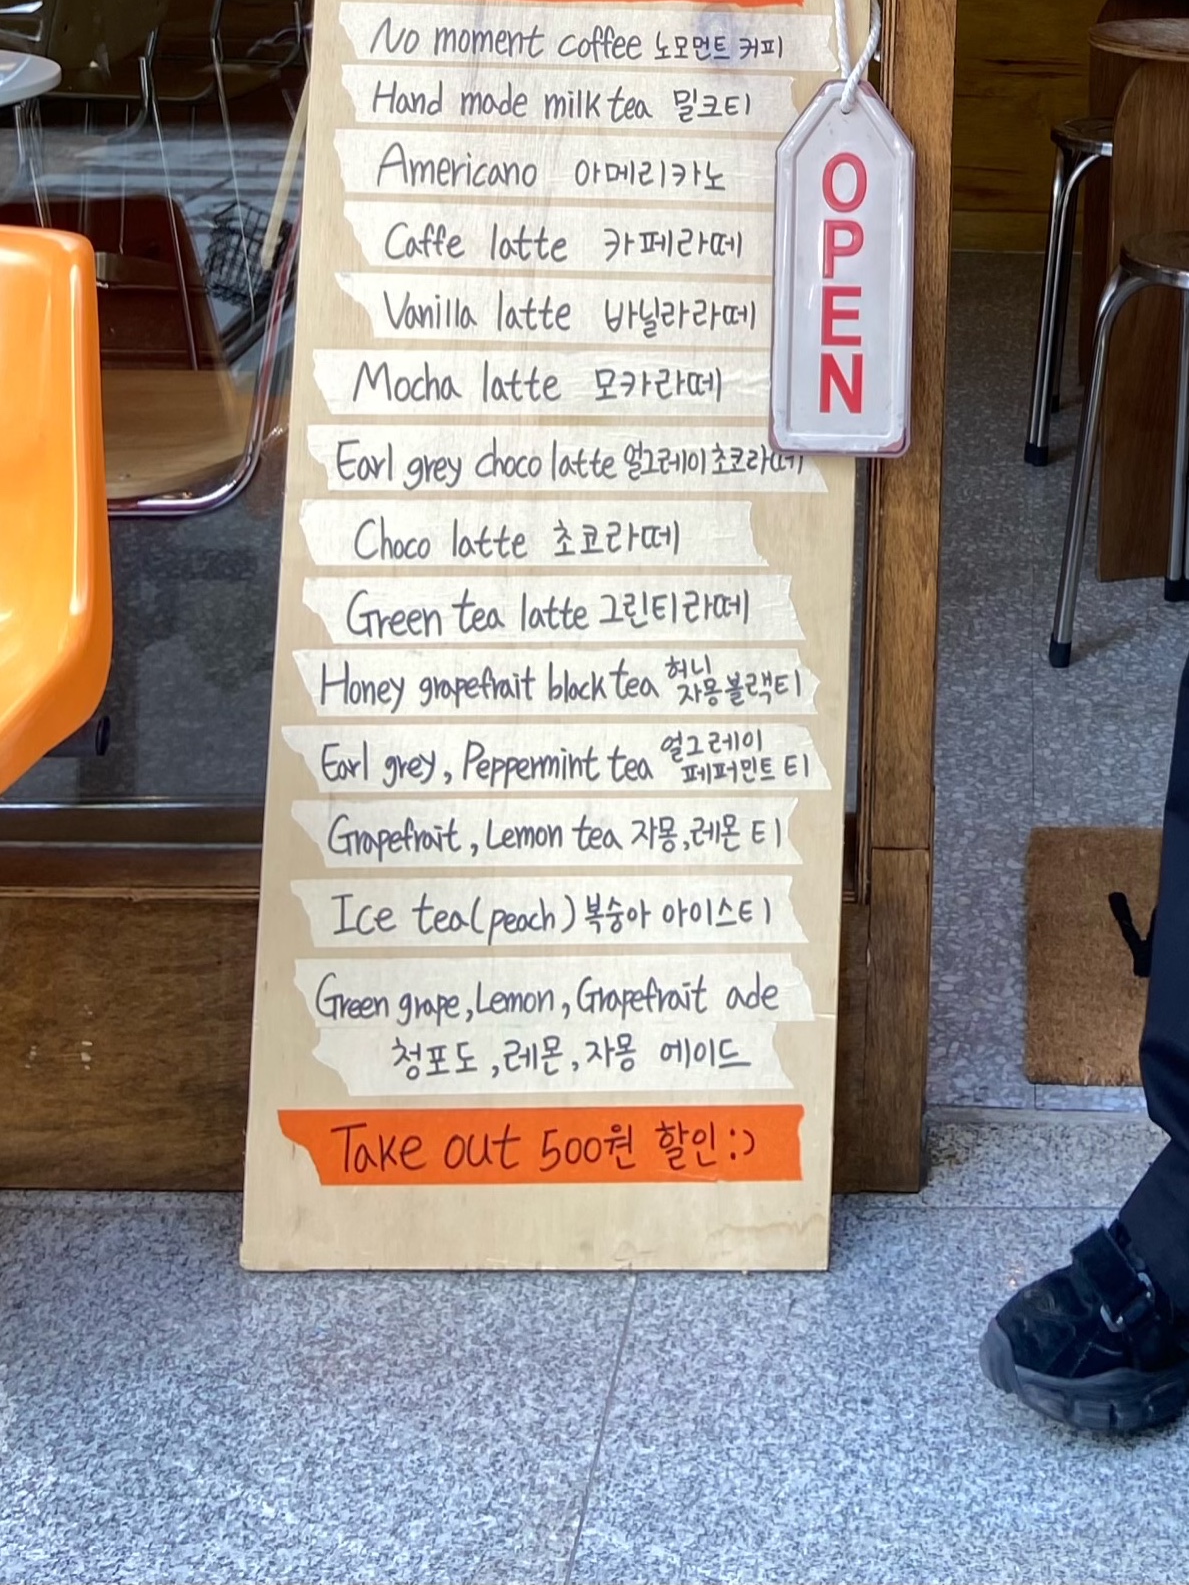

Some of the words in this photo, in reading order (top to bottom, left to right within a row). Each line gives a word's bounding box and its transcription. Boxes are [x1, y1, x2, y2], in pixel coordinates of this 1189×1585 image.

[369, 17, 420, 57] No
[434, 19, 545, 60] moment
[558, 31, 643, 61] coffee
[654, 32, 731, 61] 노모먼트
[739, 35, 784, 60] 커피
[372, 79, 443, 117] Hand
[460, 79, 528, 117] made
[545, 81, 601, 120] milk
[607, 84, 653, 120] tea
[673, 88, 752, 119] 밀크티
[377, 142, 538, 190] Americano
[575, 159, 727, 193] 아메리카노
[384, 221, 466, 261] Caffe
[491, 223, 569, 264] latte
[604, 227, 743, 260] 카페라떼
[818, 151, 868, 415] OPEN
[382, 290, 479, 332] Vanilla
[497, 290, 571, 332] latte
[605, 297, 756, 339] 바닐라라떼
[352, 359, 462, 403] Mocha
[482, 360, 561, 402] latte
[594, 365, 722, 404] 모카라떼
[336, 438, 393, 482] Earl
[402, 450, 462, 490] grey
[474, 436, 542, 480] choco
[551, 439, 616, 479] latte
[354, 516, 431, 562] Choco
[452, 519, 528, 559] latte
[553, 519, 680, 558] 초코라떼
[346, 590, 443, 638] Green
[451, 588, 505, 630] tea
[520, 591, 590, 630] latte
[320, 660, 406, 713] Honey
[609, 658, 660, 699] tea
[665, 653, 713, 680] 허니
[321, 740, 369, 782] Earl
[462, 740, 600, 789] Peppermint
[606, 743, 654, 782] tea
[485, 814, 564, 851] Lemon
[572, 815, 624, 851] tea
[331, 893, 397, 935] Ice
[584, 890, 652, 935] 복숭아
[662, 896, 772, 926] 아이스티
[315, 972, 390, 1020] Green
[725, 970, 780, 1011] ade
[660, 1037, 753, 1070] 에이드
[330, 1123, 426, 1175] Take
[443, 1121, 521, 1170] out
[538, 1121, 635, 1174] 500원
